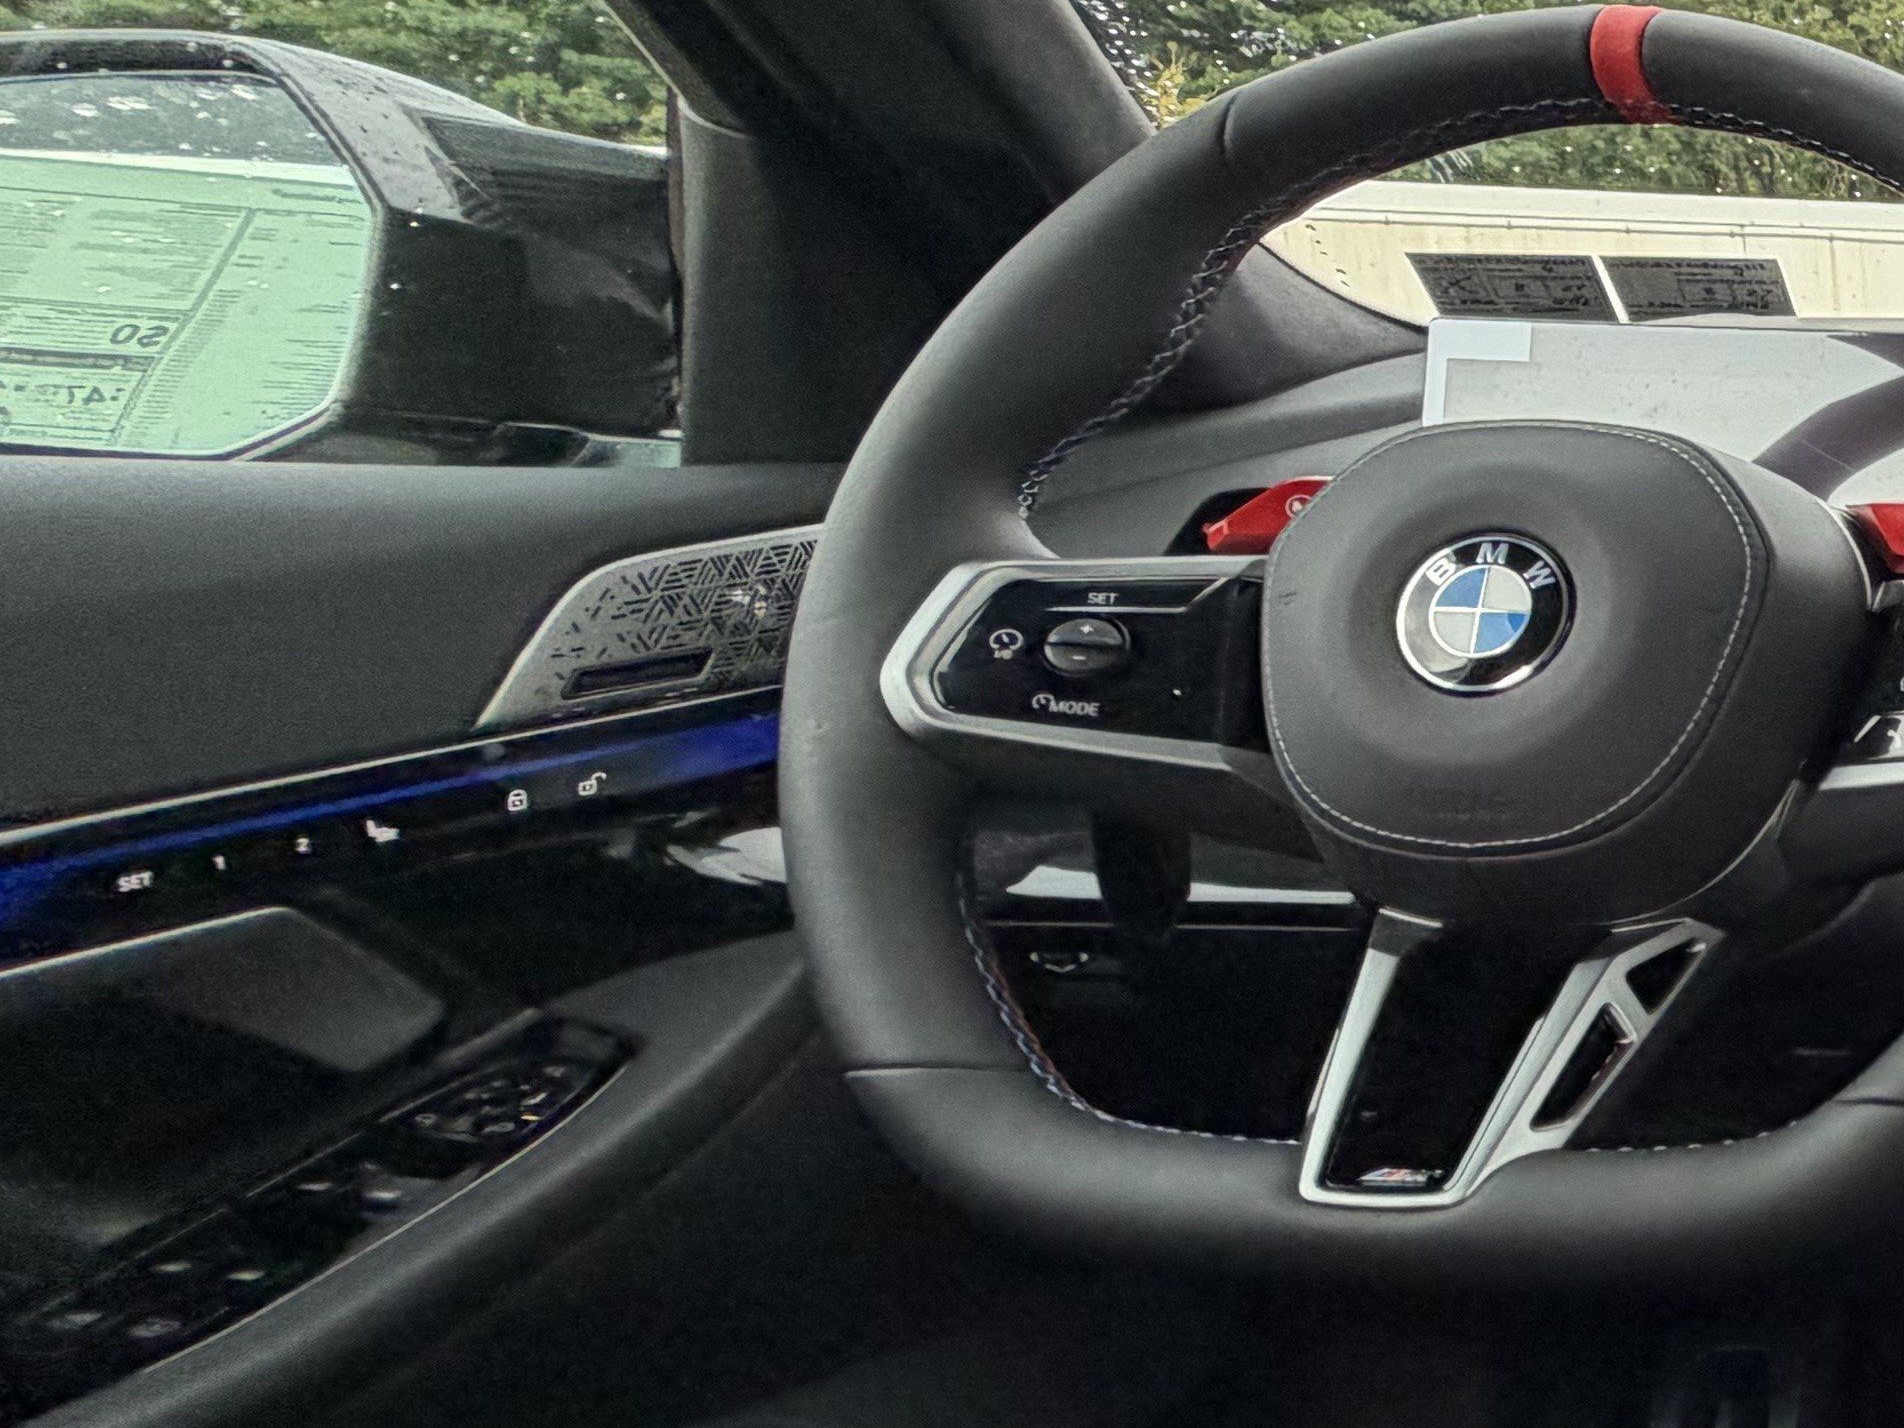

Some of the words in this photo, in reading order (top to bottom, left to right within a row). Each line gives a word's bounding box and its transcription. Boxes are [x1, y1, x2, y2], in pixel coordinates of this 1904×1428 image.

[1425, 541, 1558, 590] BMW
[1087, 590, 1120, 606] SET
[1051, 700, 1101, 718] MODE
[115, 871, 153, 893] SET
[294, 837, 312, 853] 2
